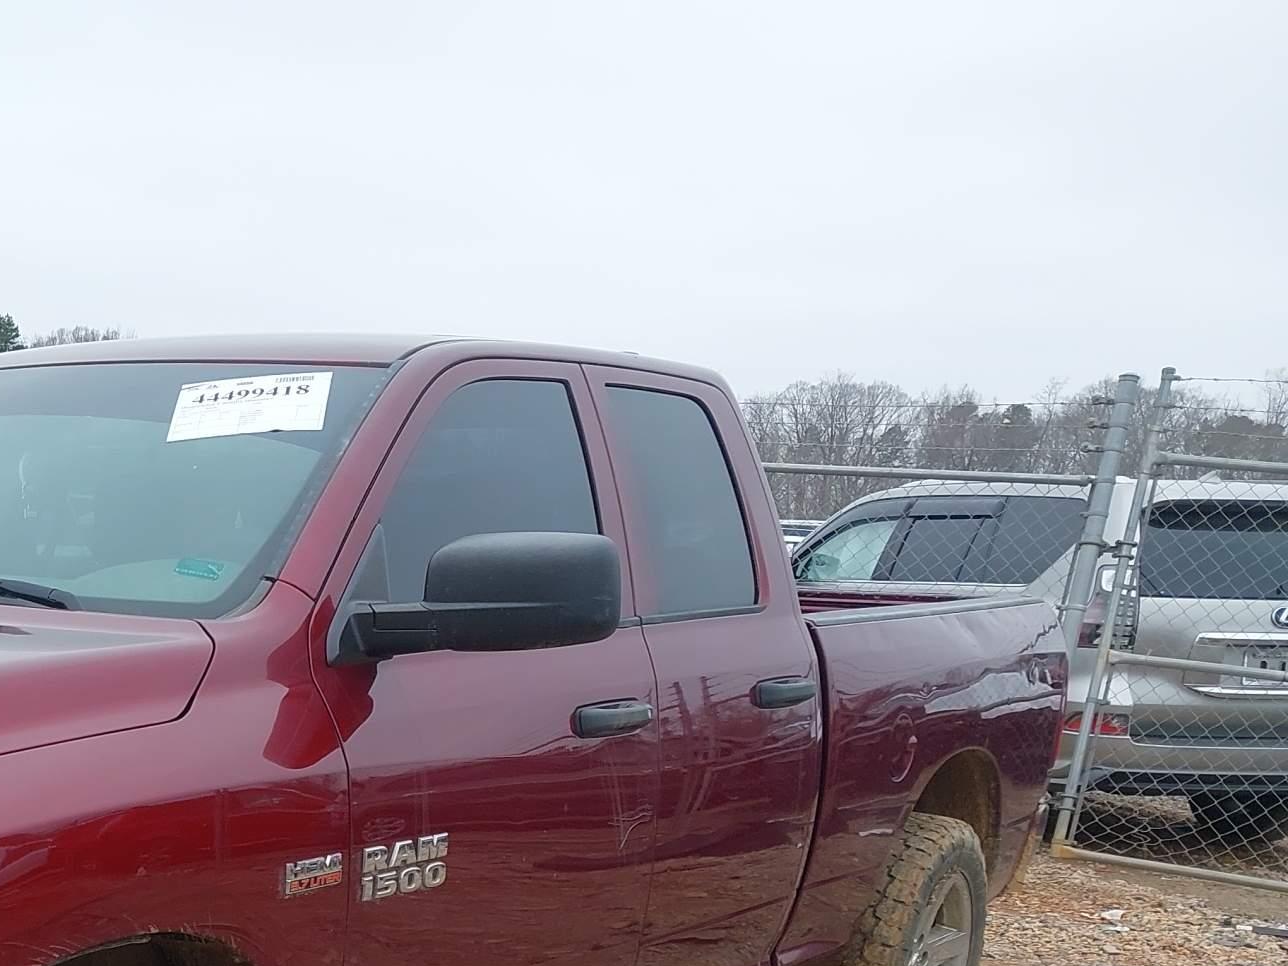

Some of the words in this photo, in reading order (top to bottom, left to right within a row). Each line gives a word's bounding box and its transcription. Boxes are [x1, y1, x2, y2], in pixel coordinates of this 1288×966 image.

[192, 384, 311, 403] 44499418
[286, 853, 342, 880] HEMI
[363, 833, 448, 873] RAM
[310, 870, 342, 888] LITER
[362, 861, 447, 901] 1500
